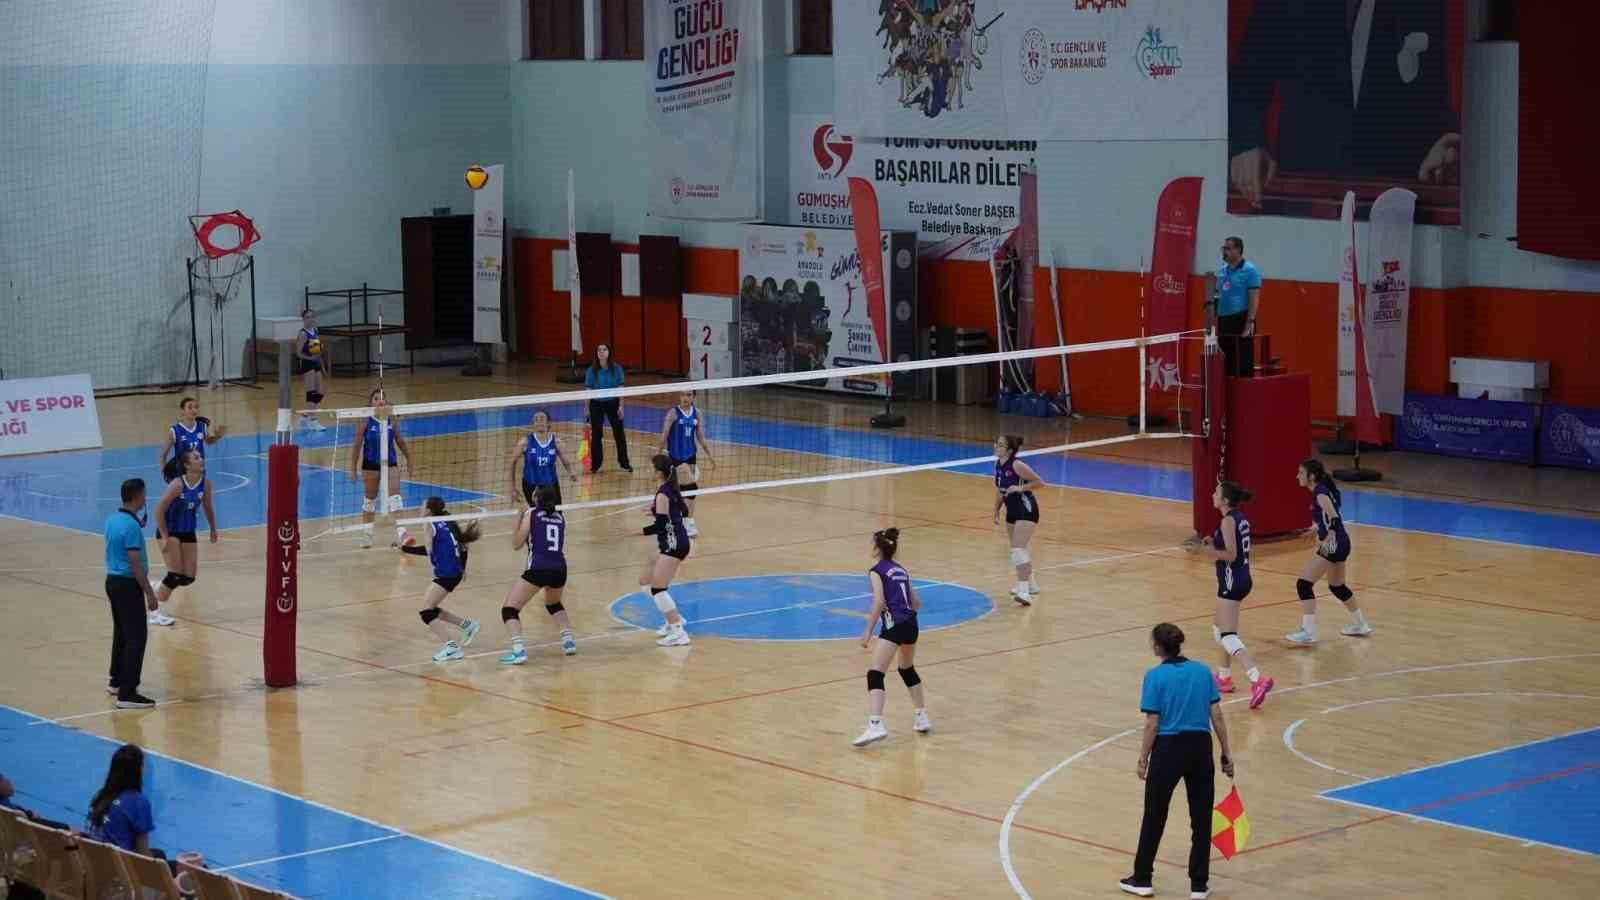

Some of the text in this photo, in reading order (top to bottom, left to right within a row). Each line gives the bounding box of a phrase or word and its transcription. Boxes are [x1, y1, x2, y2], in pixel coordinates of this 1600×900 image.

[674, 0, 723, 39] GÜCÜ
[657, 27, 739, 80] GENÇLİĞİ
[1051, 41, 1107, 56] T.C. GENÇLİK VE
[1051, 54, 1107, 69] SPOR BAKANLIĞI
[875, 159, 970, 187] BAŞARILAR
[955, 203, 981, 217] Soner
[984, 205, 1015, 220] BAŞER
[921, 220, 961, 235] Belediye
[703, 325, 711, 346] 2
[700, 352, 708, 380] 1
[6, 394, 85, 414] VE SPOR
[0, 418, 28, 437] IĞI
[546, 524, 559, 552] 9
[282, 545, 292, 589] TVF
[899, 582, 912, 610] 1
